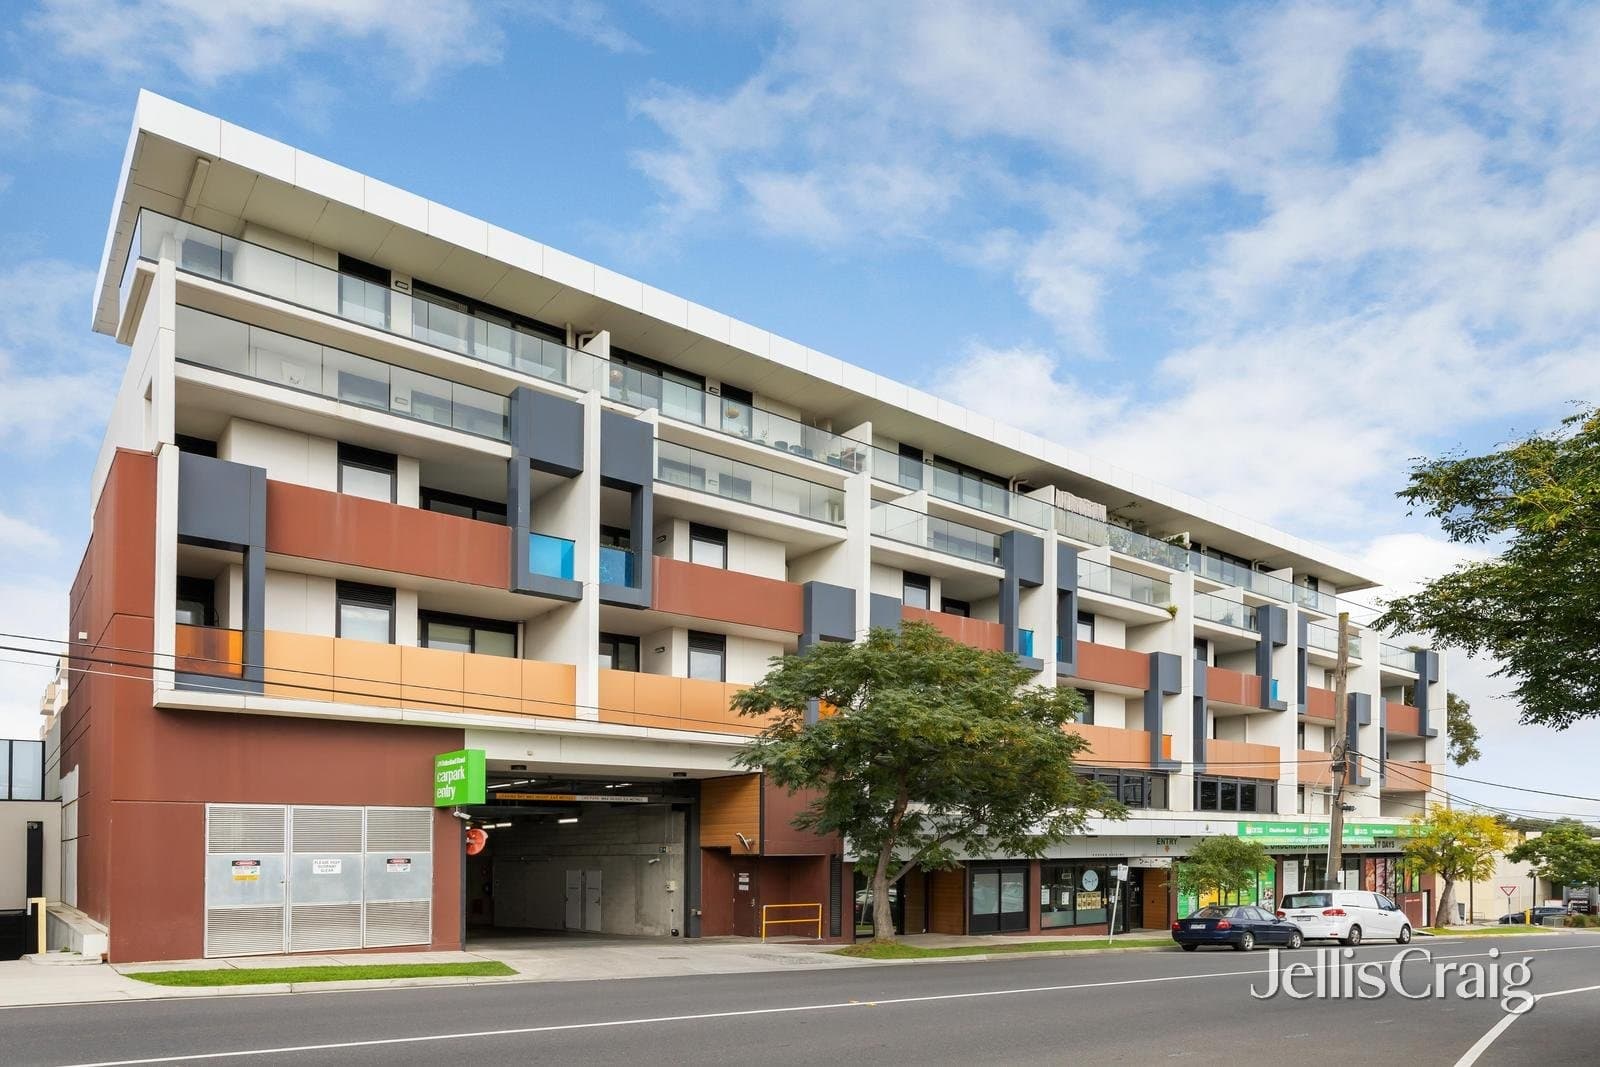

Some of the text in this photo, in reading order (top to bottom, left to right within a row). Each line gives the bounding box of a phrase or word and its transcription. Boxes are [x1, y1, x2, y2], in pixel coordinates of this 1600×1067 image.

[437, 766, 466, 785] carpark
[437, 784, 456, 801] entry
[1156, 837, 1178, 845] ENTRY
[1382, 840, 1395, 849] DAYS
